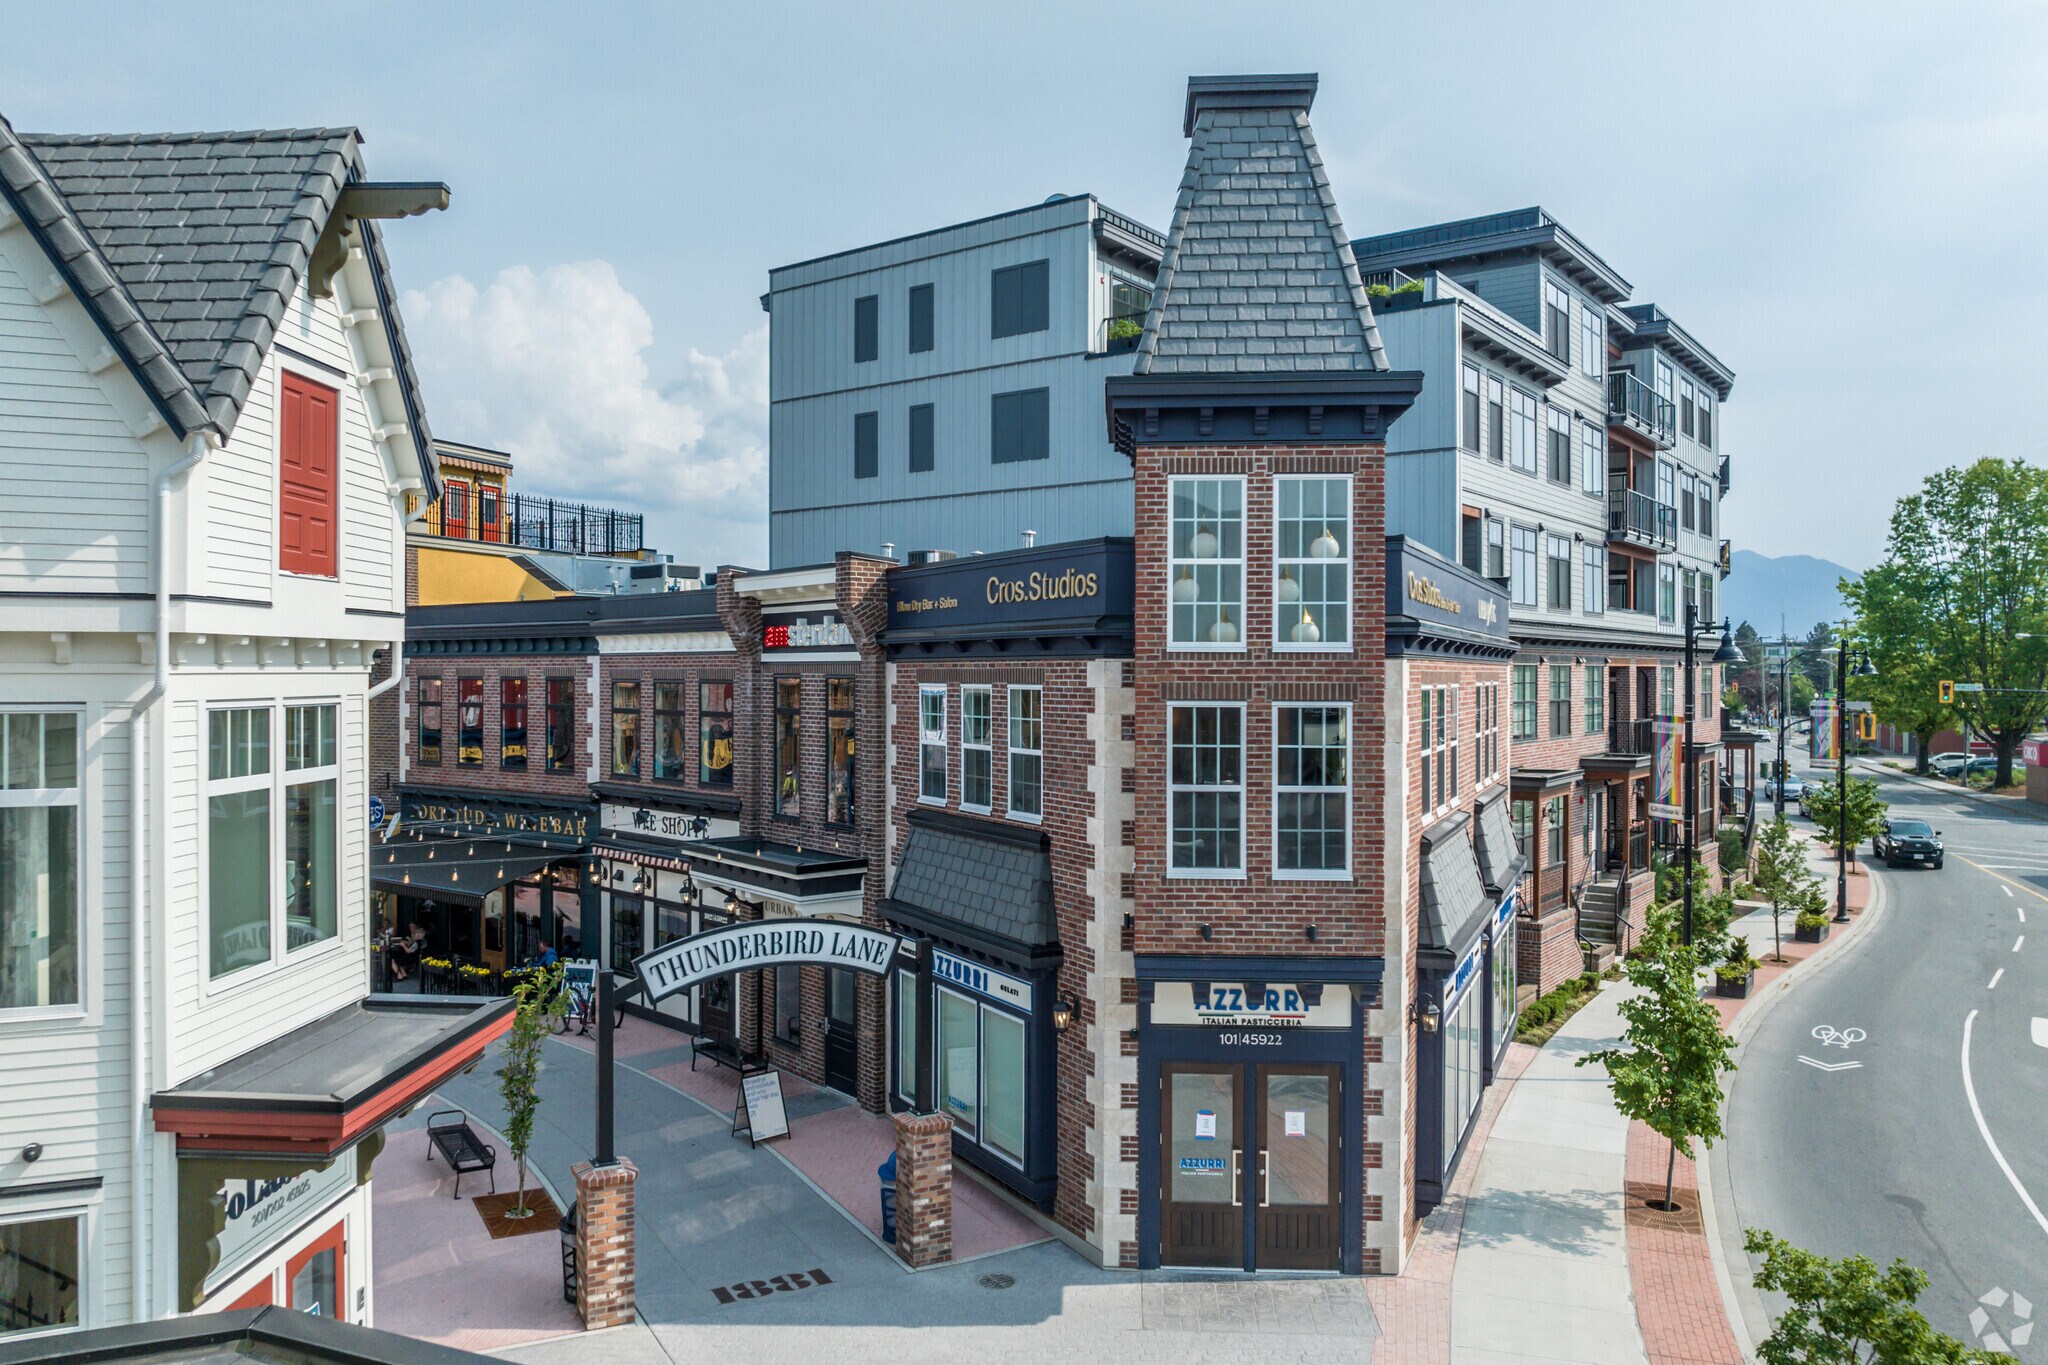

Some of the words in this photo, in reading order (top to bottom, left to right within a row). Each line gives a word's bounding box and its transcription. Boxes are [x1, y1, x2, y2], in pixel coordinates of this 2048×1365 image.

[987, 568, 1098, 605] Cros.Studios
[922, 598, 933, 610] Bar
[939, 597, 958, 608] Salon
[410, 804, 495, 826] ORTTUD
[553, 818, 587, 836] BAR
[765, 900, 793, 916] URBAN
[649, 930, 824, 987] THUNDERBIRD
[831, 932, 888, 965] LANE
[1000, 984, 1019, 997] GELATI
[1195, 988, 1309, 1012] ZZRR
[1241, 1018, 1302, 1026] PASTICCERIA
[1179, 1158, 1226, 1169] AZZURRI
[711, 1268, 838, 1305] 1881
